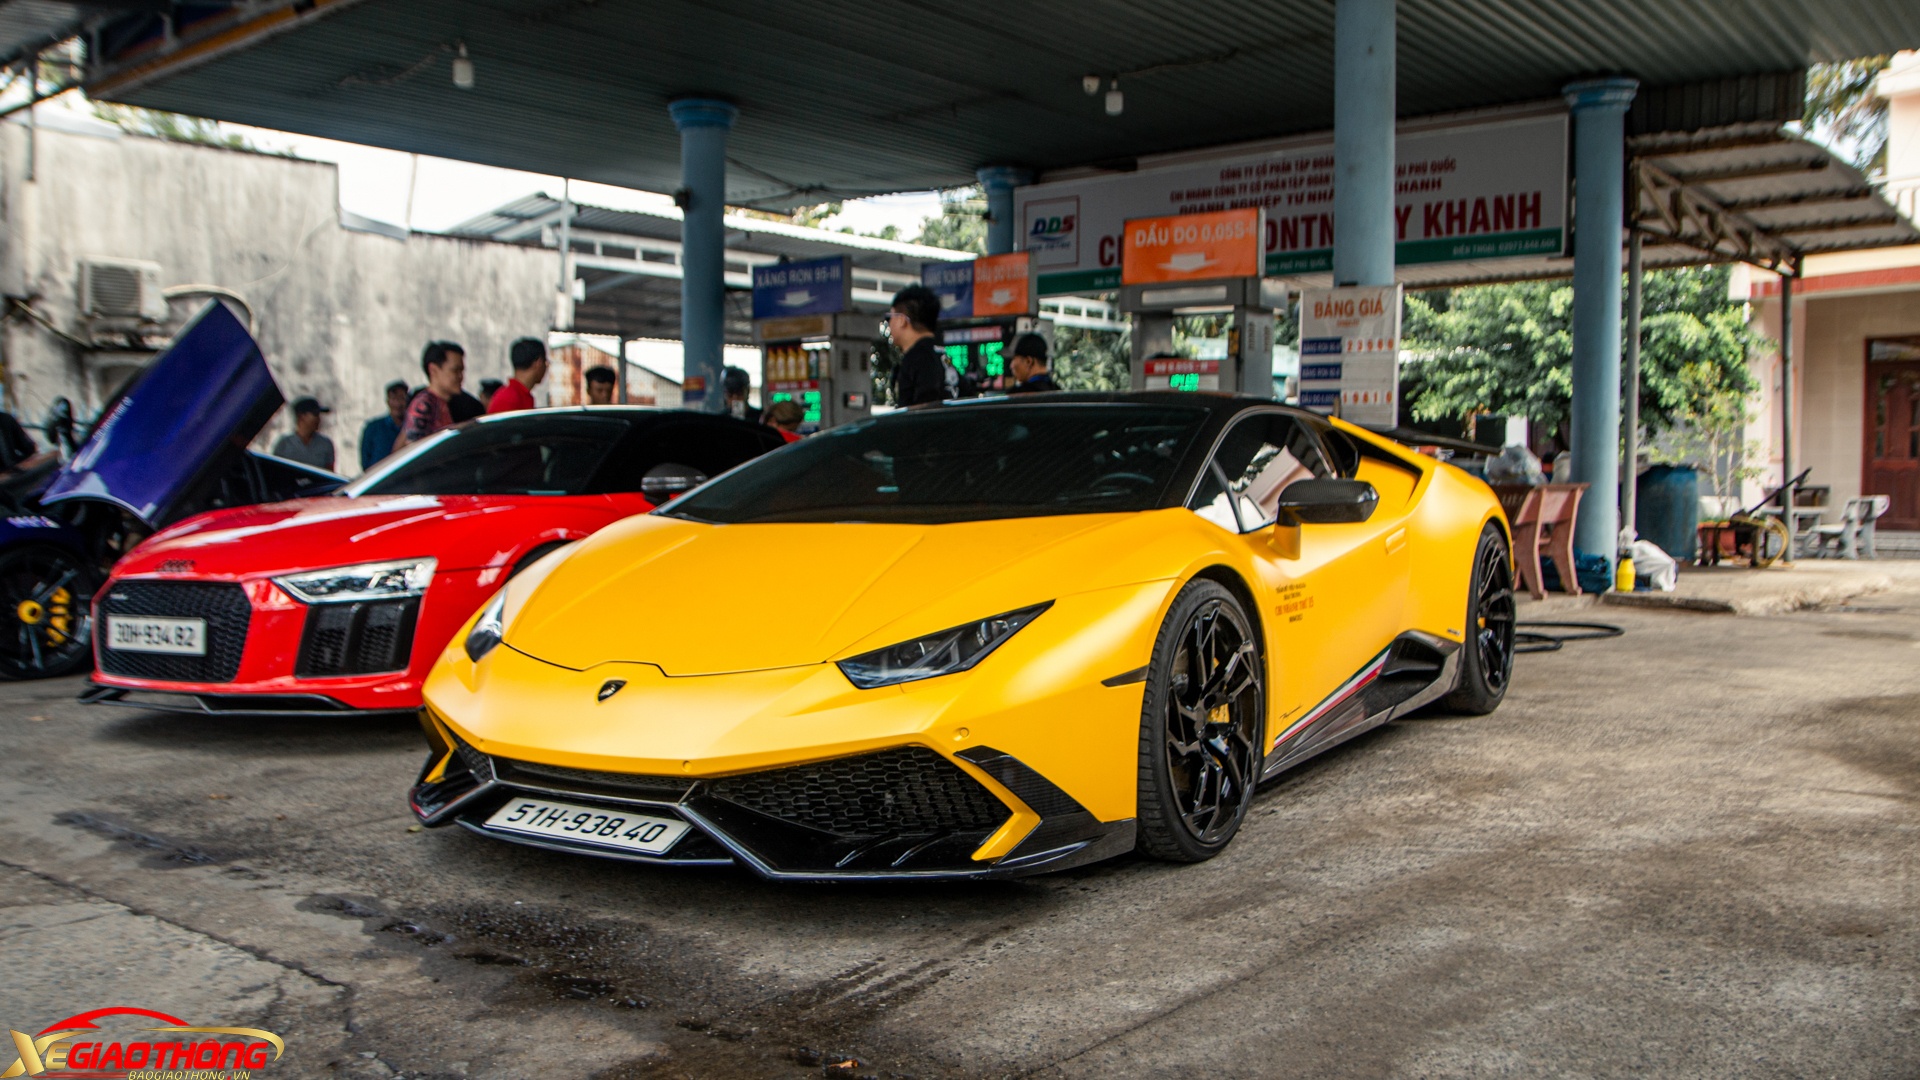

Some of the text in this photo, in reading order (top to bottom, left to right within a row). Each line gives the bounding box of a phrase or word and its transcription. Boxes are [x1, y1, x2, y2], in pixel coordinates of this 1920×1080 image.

[1030, 215, 1075, 235] DDS
[1423, 191, 1542, 239] KHANH
[1173, 225, 1198, 244] DO
[1314, 290, 1384, 319] BẢNG GIÁ
[507, 804, 668, 843] 51H-938.40
